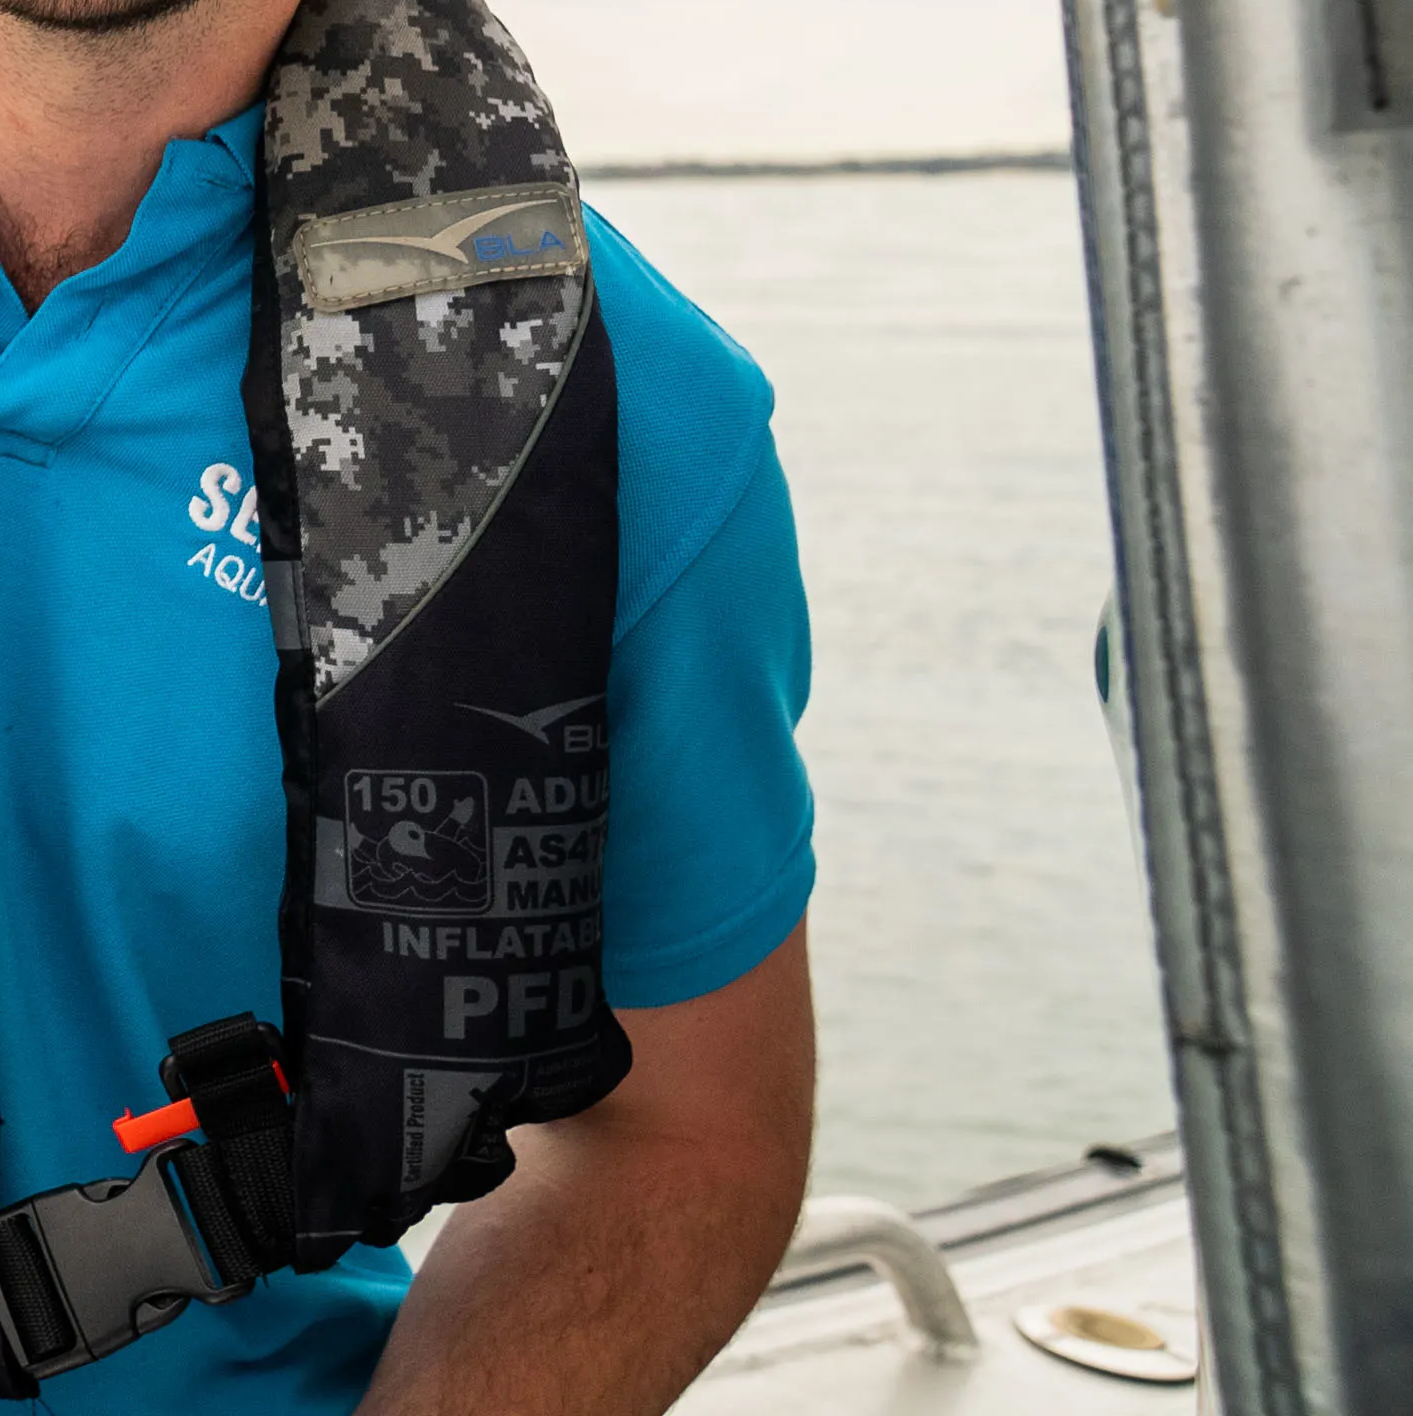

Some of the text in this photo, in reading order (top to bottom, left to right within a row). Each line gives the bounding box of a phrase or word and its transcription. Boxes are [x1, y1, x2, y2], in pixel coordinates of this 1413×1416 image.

[474, 230, 565, 261] BLA
[189, 463, 261, 553] SE
[187, 543, 267, 606] AQU
[353, 776, 437, 813] 150
[504, 827, 606, 869] AS47
[443, 964, 596, 1039] PFD
[403, 1073, 425, 1182] Certified Product
